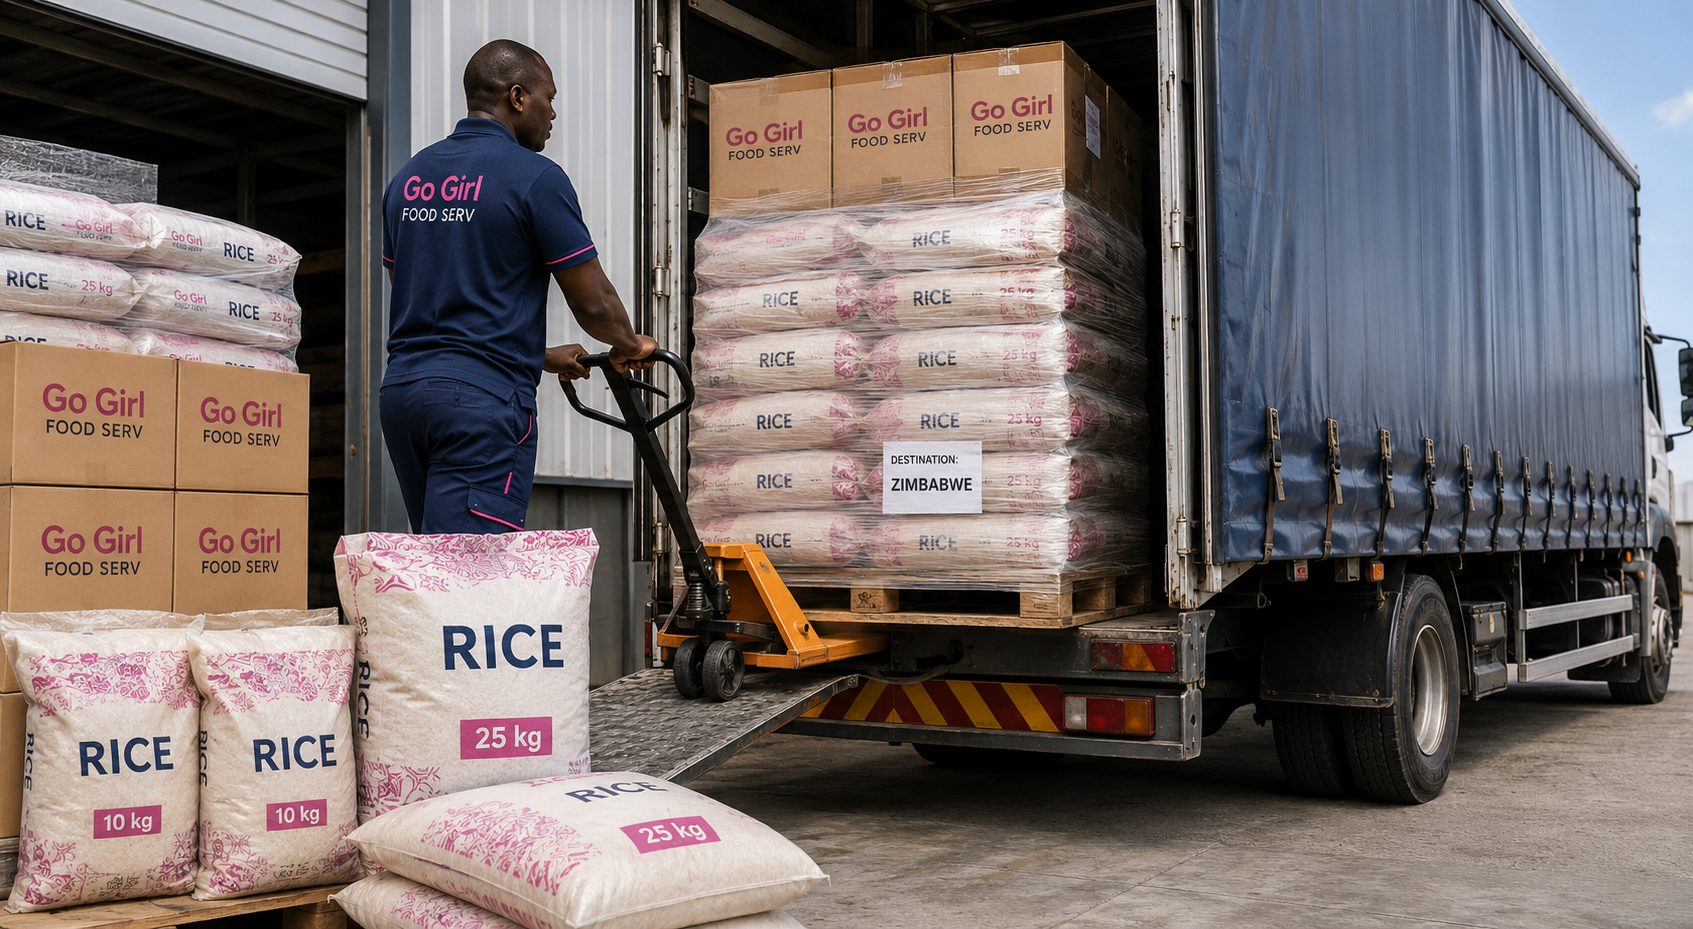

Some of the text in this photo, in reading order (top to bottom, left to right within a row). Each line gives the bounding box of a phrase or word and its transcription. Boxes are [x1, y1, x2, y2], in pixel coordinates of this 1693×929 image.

[970, 94, 1053, 121] Go Girl
[848, 107, 928, 133] Go Girl
[974, 119, 1051, 136] FOOD SERV
[725, 120, 803, 147] Go Girl
[850, 131, 927, 148] FOOD SERV
[728, 145, 801, 161] FOOD SERV
[403, 175, 483, 202] Go Girl
[5, 210, 46, 230] RICE
[402, 207, 475, 222] FOOD SERV
[76, 220, 113, 234] Go Girl
[1001, 229, 1016, 239] 25
[171, 231, 203, 246] Go Girl
[912, 230, 951, 247] RICE
[224, 242, 255, 262] RICE
[7, 270, 49, 290] RICE
[82, 280, 97, 291] 25
[99, 281, 113, 297] kg
[174, 290, 207, 305] Go Girl
[762, 291, 798, 308] RICE
[913, 289, 952, 307] RICE
[229, 301, 260, 321] RICE
[760, 351, 795, 368] RICE
[918, 350, 957, 368] RICE
[1003, 350, 1018, 360] 25
[42, 383, 145, 418] Go Girl
[200, 396, 282, 428] Go Girl
[921, 412, 960, 429] RICE
[1008, 414, 1042, 426] 25 kg
[46, 419, 143, 439] FOOD SERV
[757, 413, 792, 430] RICE
[203, 429, 280, 447] FOOD SERV
[891, 455, 958, 465] DESTINATION:
[757, 473, 793, 489] RICE
[891, 478, 972, 492] ZIMBABWE
[1007, 476, 1022, 486] 25
[41, 525, 142, 555] Go Girl
[199, 527, 281, 554] Go Girl
[756, 533, 791, 548] RICE
[919, 534, 958, 551] RICE
[45, 561, 141, 577] FOOD SERV
[201, 560, 279, 574] FOOD SERV
[443, 624, 565, 670] RICE
[358, 661, 371, 739] RICE
[475, 724, 542, 752] 25 kg
[25, 733, 34, 790] RICE
[79, 736, 174, 777] RICE
[252, 734, 337, 772] RICE
[565, 781, 669, 803] RICE
[103, 811, 153, 837] 10 kg
[275, 805, 320, 828] 10 kg
[638, 821, 707, 844] 25 kg
